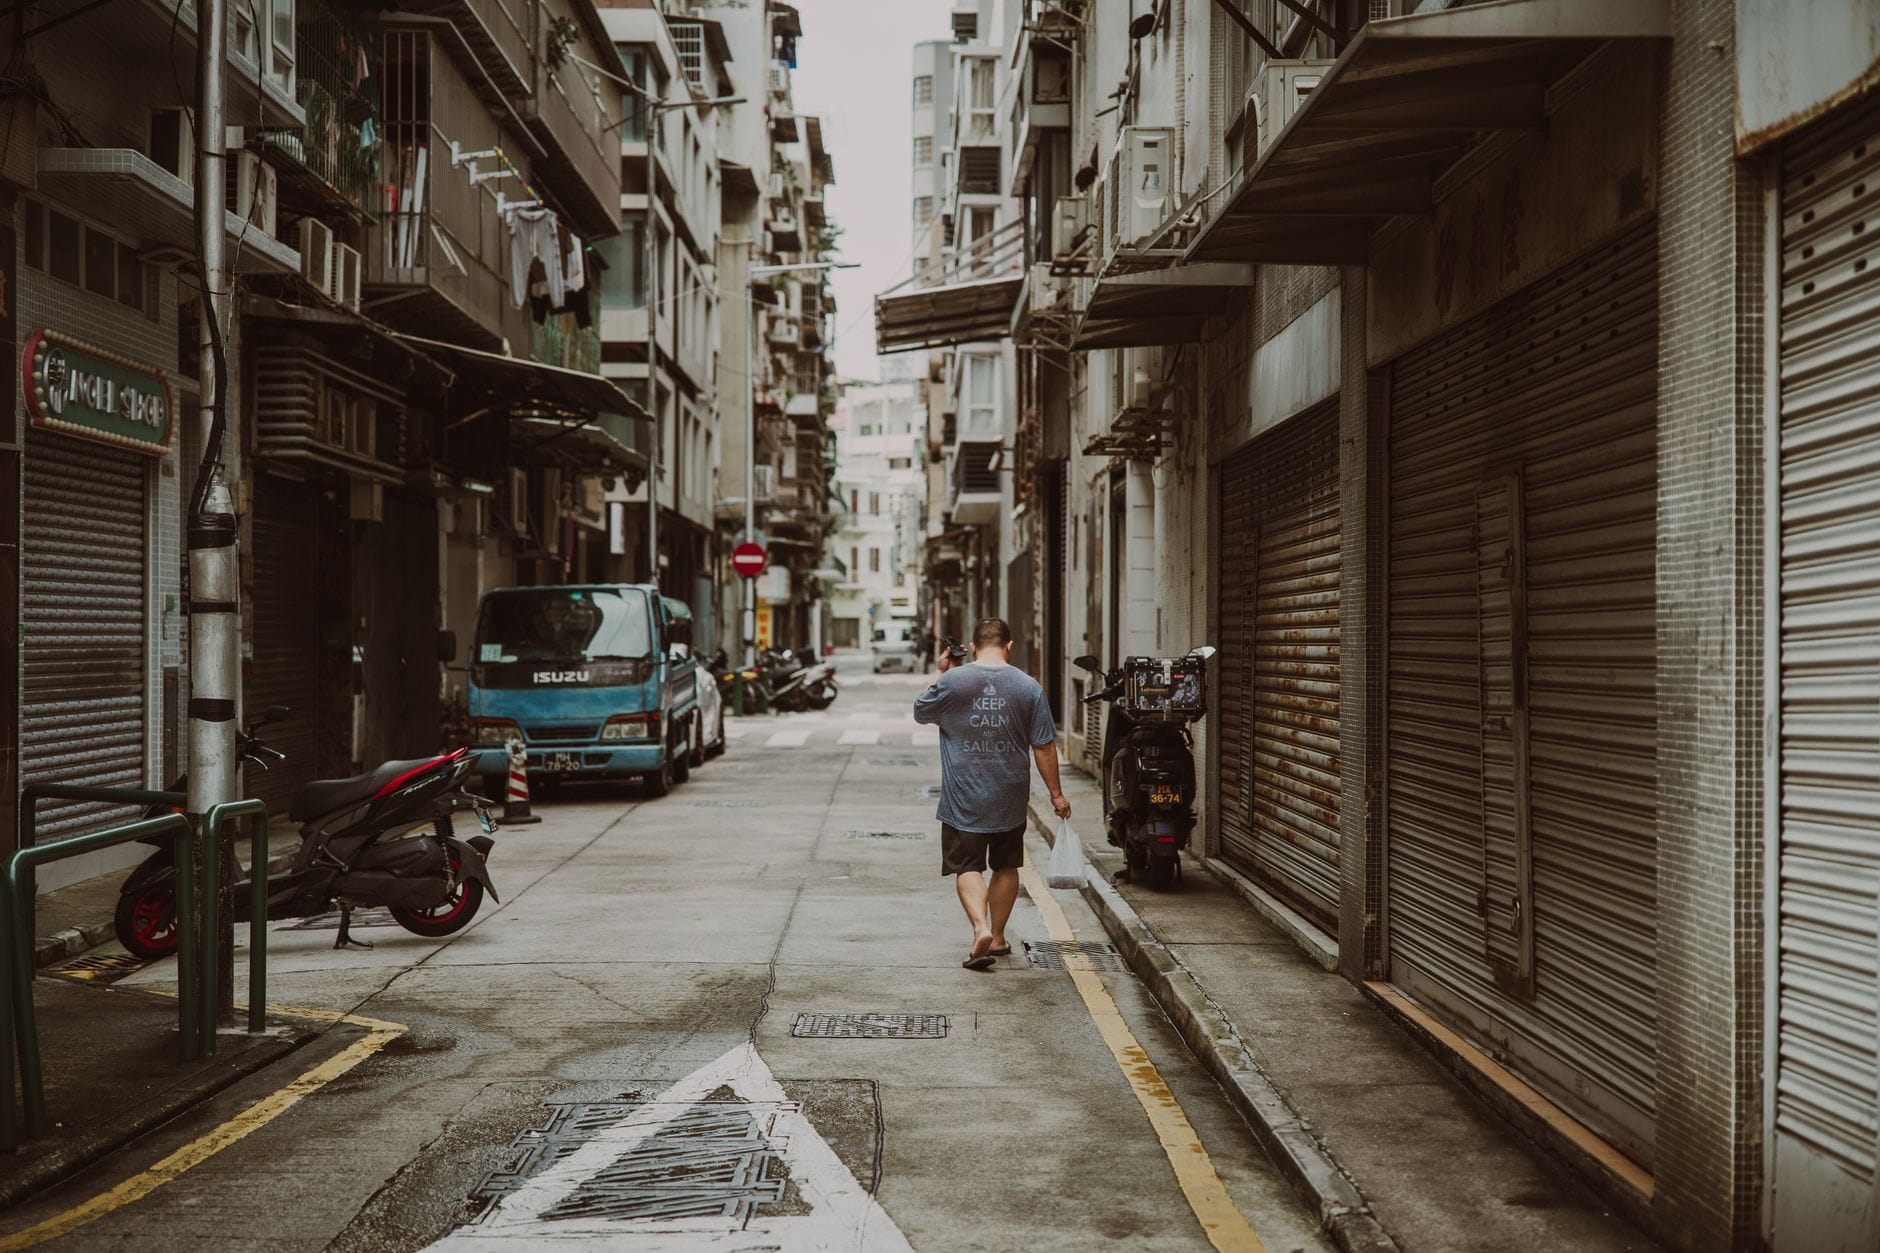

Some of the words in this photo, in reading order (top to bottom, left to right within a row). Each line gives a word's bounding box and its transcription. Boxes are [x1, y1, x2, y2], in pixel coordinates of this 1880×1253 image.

[70, 369, 118, 413] NOEL
[120, 386, 164, 427] SHOP
[533, 671, 590, 684] ISUZU
[973, 697, 1007, 710] KEEP
[970, 715, 1009, 727] CALM
[963, 740, 993, 753] SAIL
[995, 740, 1016, 753] ON
[555, 752, 570, 762] MH
[547, 762, 580, 771] 78-20
[1158, 785, 1172, 793] MX
[1151, 793, 1180, 803] 36-74
